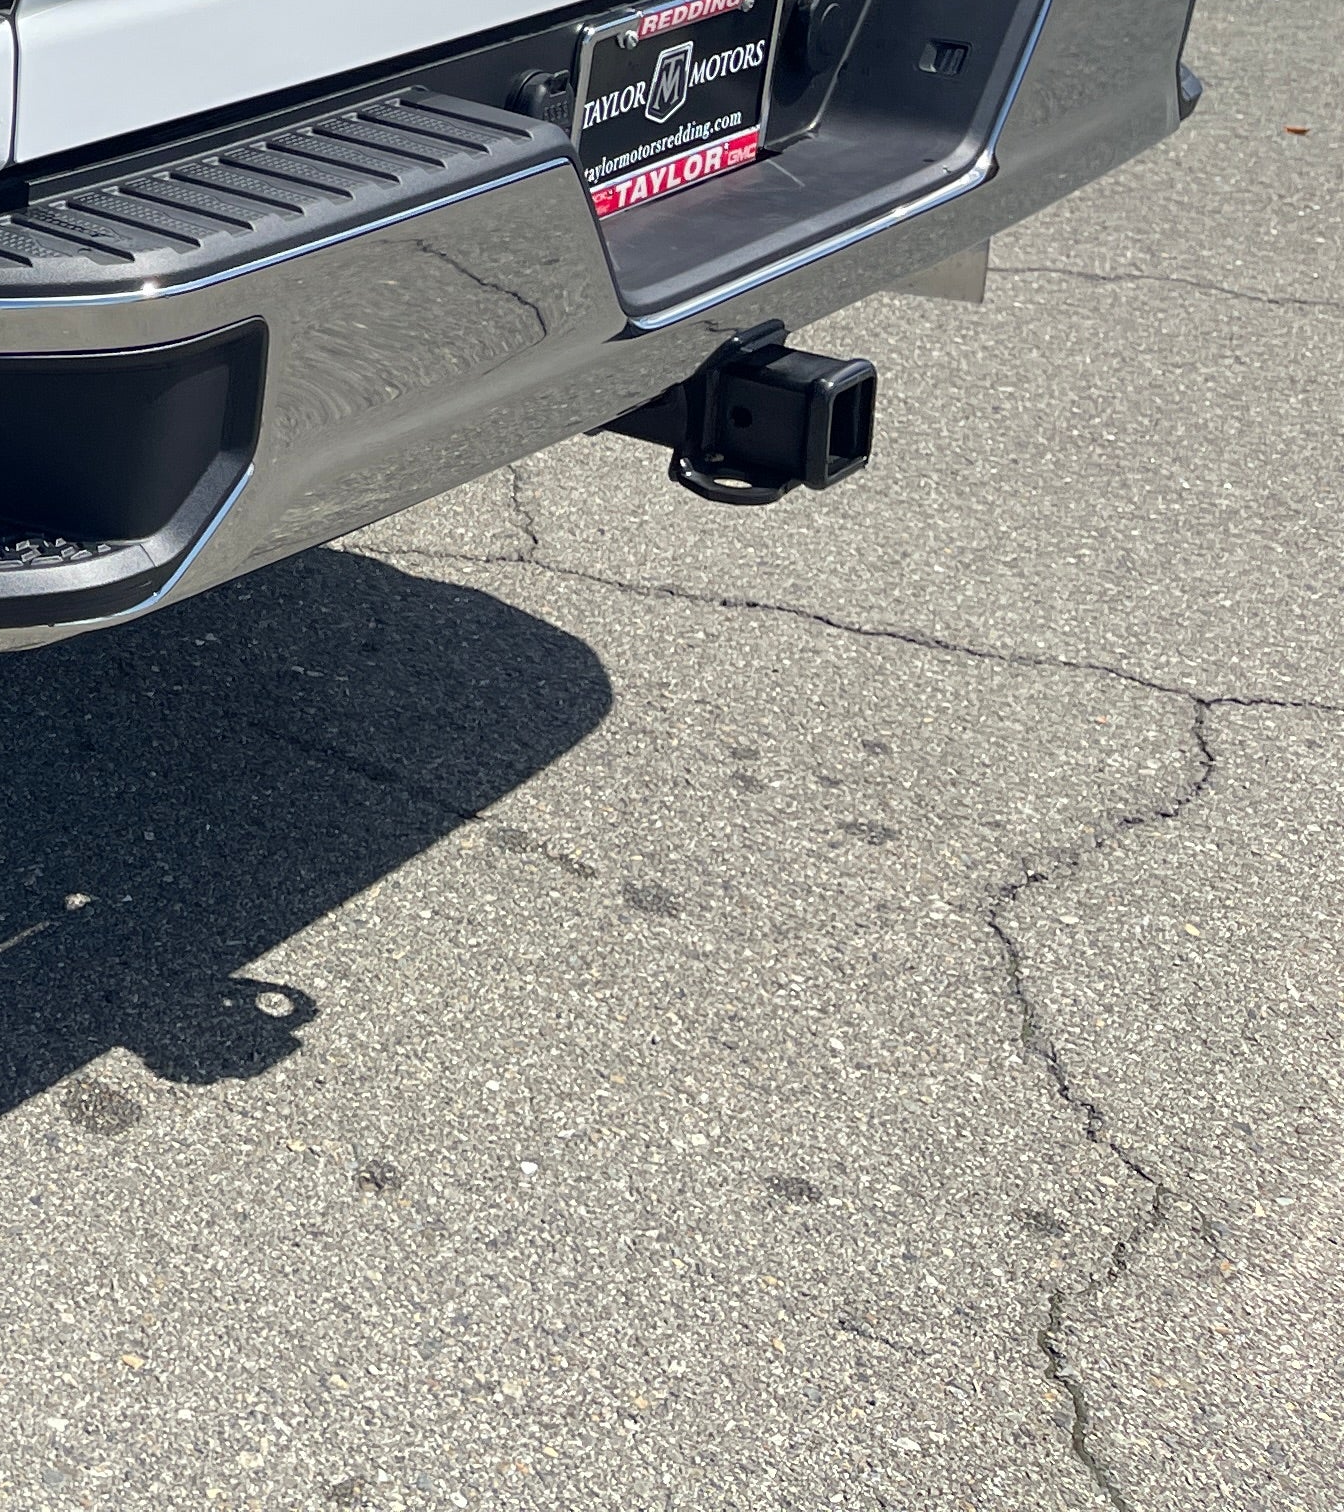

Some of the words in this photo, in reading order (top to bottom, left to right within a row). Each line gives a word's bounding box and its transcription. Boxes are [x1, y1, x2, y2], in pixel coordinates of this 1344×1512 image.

[583, 80, 647, 130] TAYLOR
[688, 40, 766, 88] MOTORS
[615, 146, 723, 209] TAYLOR
[727, 142, 757, 167] GMC
